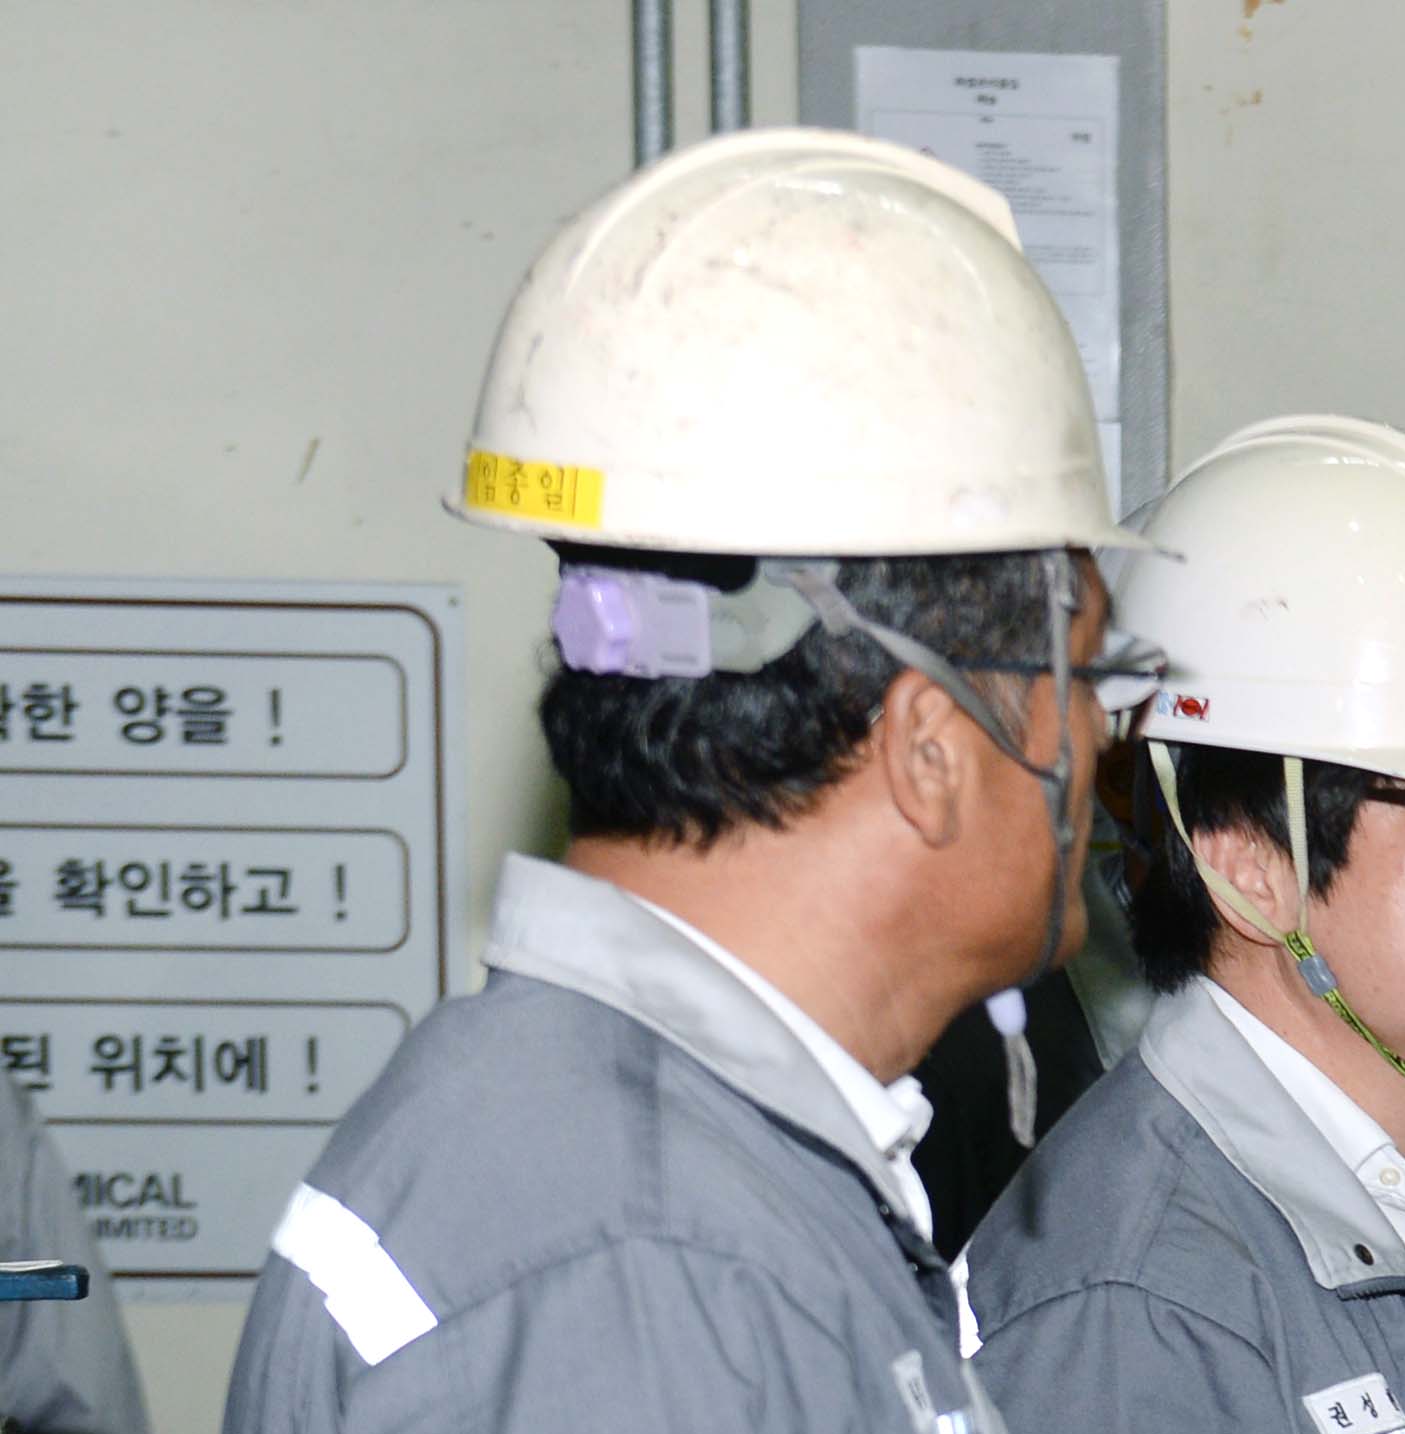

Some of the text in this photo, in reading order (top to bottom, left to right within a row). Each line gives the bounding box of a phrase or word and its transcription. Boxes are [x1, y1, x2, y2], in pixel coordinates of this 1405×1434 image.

[0, 683, 79, 741] 한
[113, 686, 232, 745] 양을
[54, 858, 299, 920] 확인하고
[89, 1034, 268, 1093] 위치에
